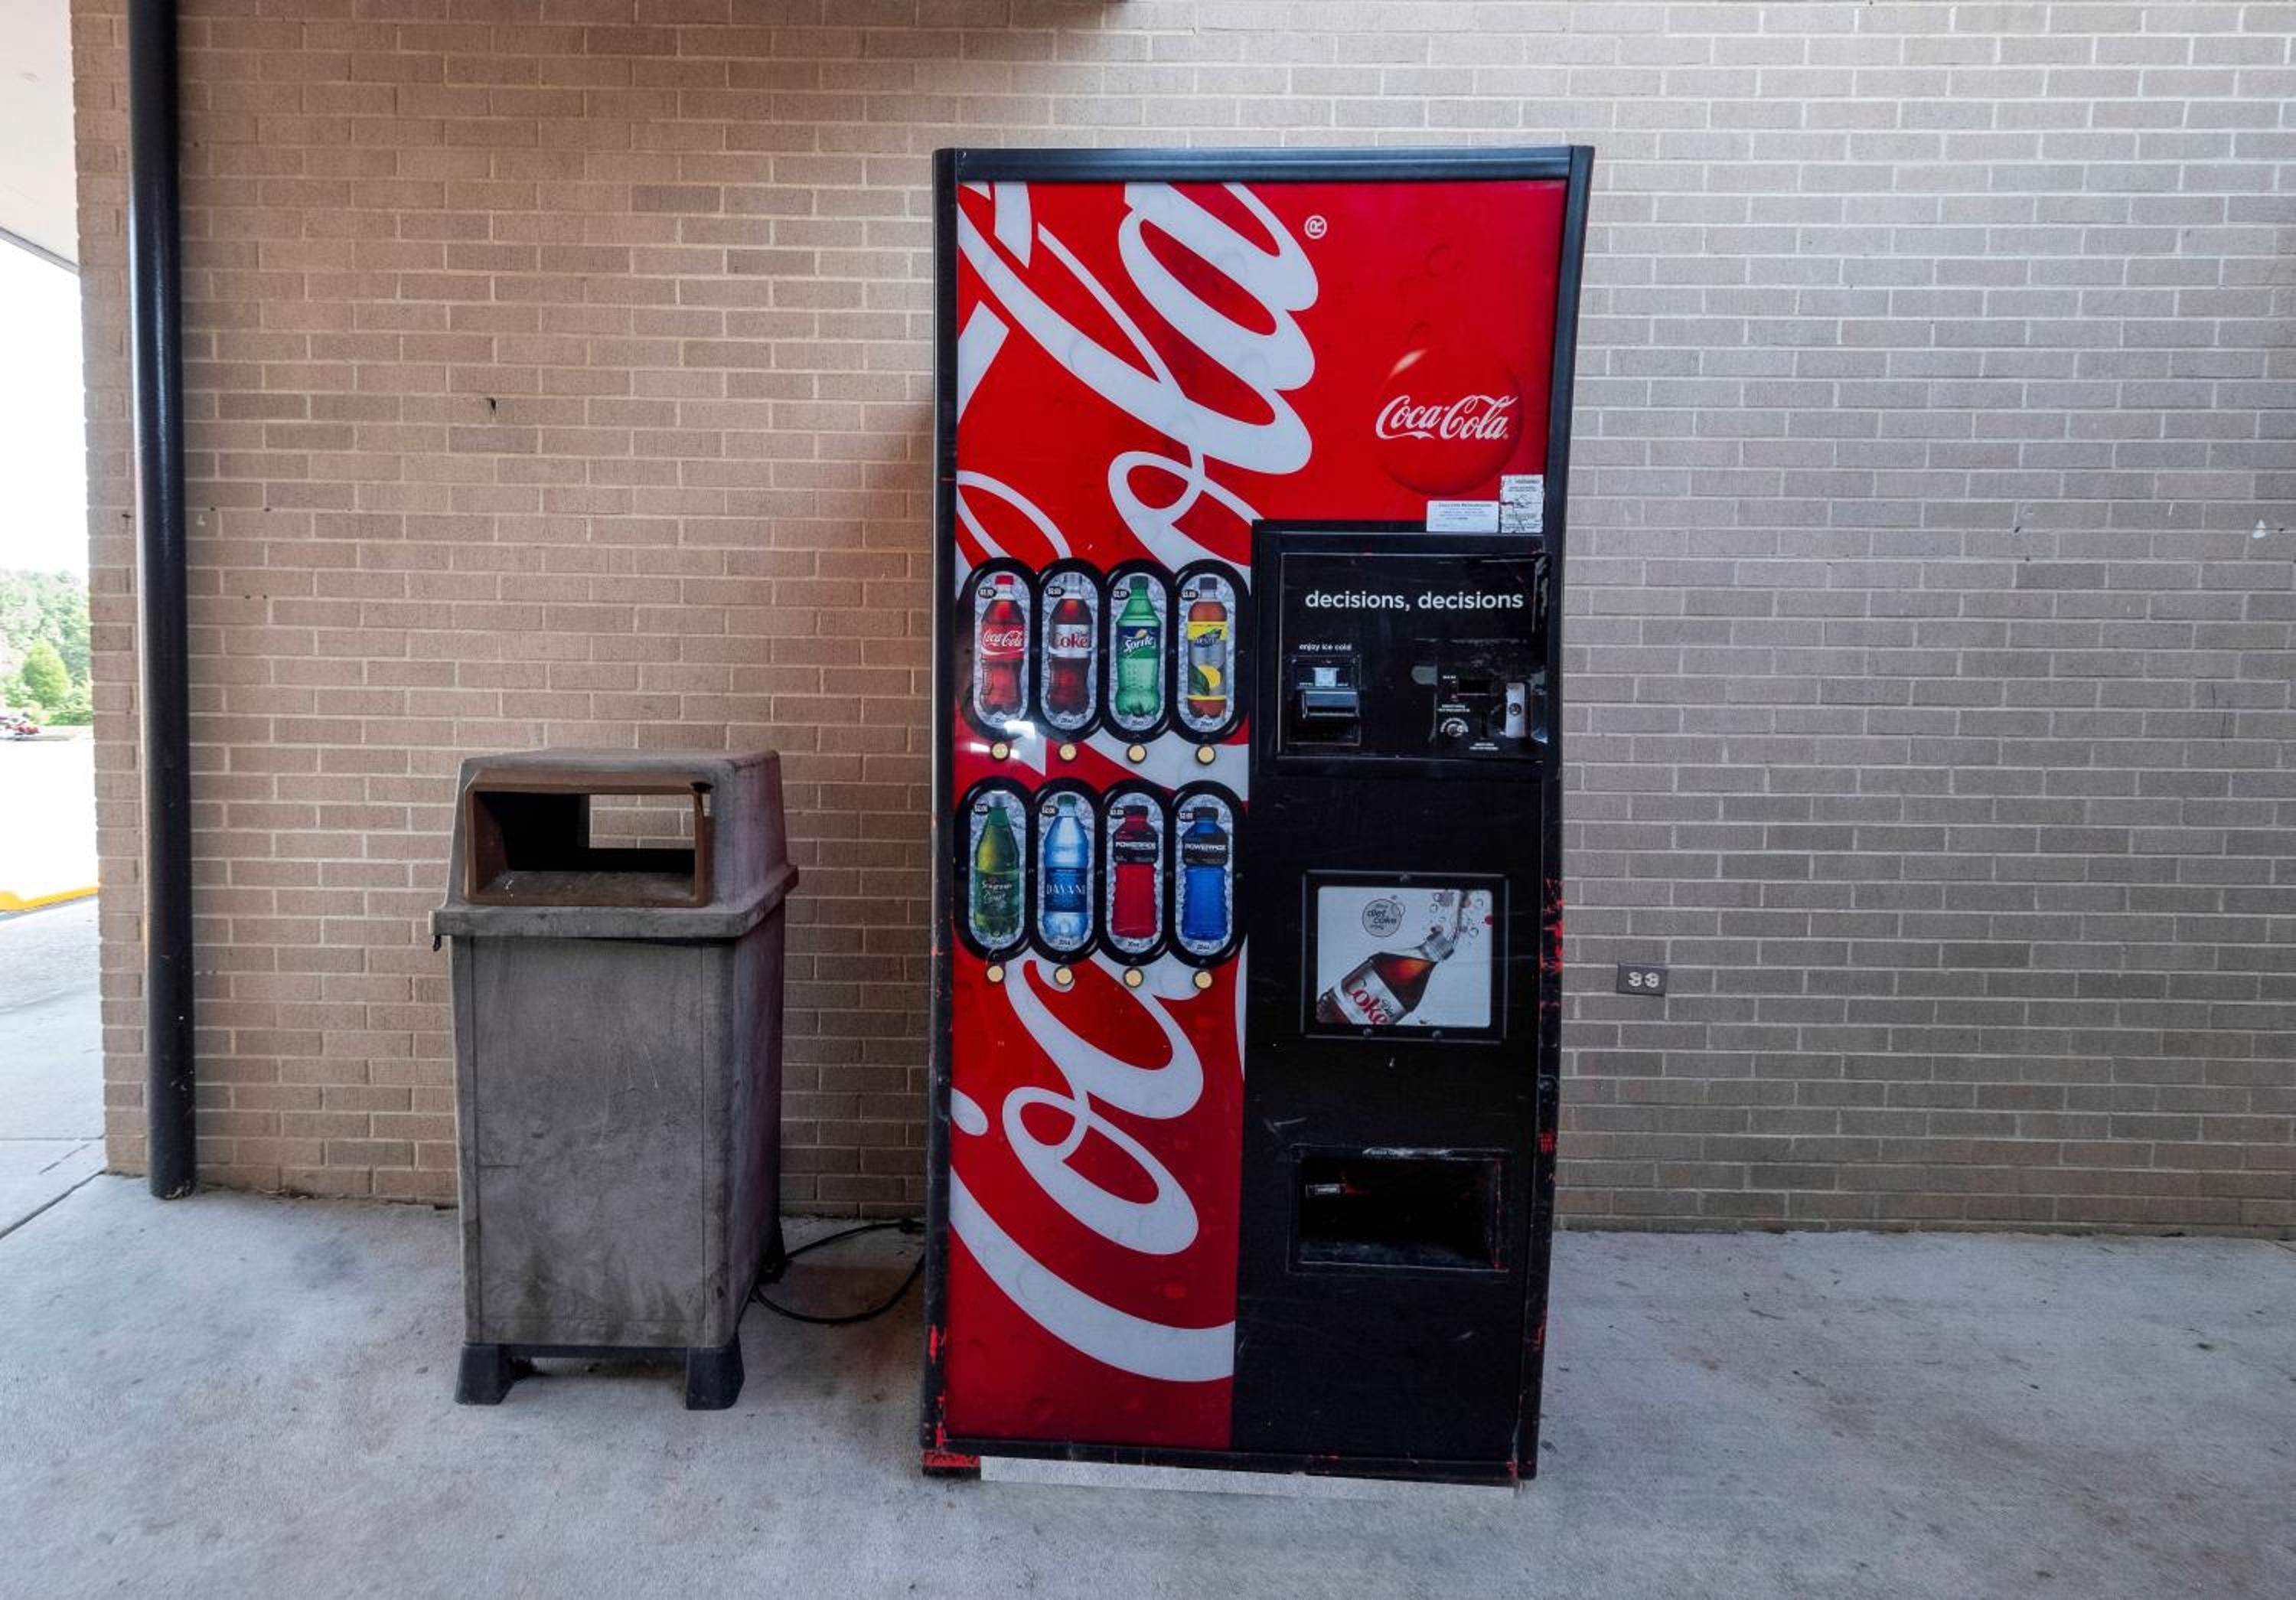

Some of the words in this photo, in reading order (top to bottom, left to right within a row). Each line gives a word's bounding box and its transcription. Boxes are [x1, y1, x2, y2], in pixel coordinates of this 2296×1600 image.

[1375, 394, 1518, 439] Coca-Cola
[1305, 590, 1411, 611] decisions,
[1417, 591, 1524, 609] decisions
[1123, 635, 1156, 653] Sprite
[1299, 643, 1320, 651] enjoy
[1344, 972, 1388, 1024] Coke
